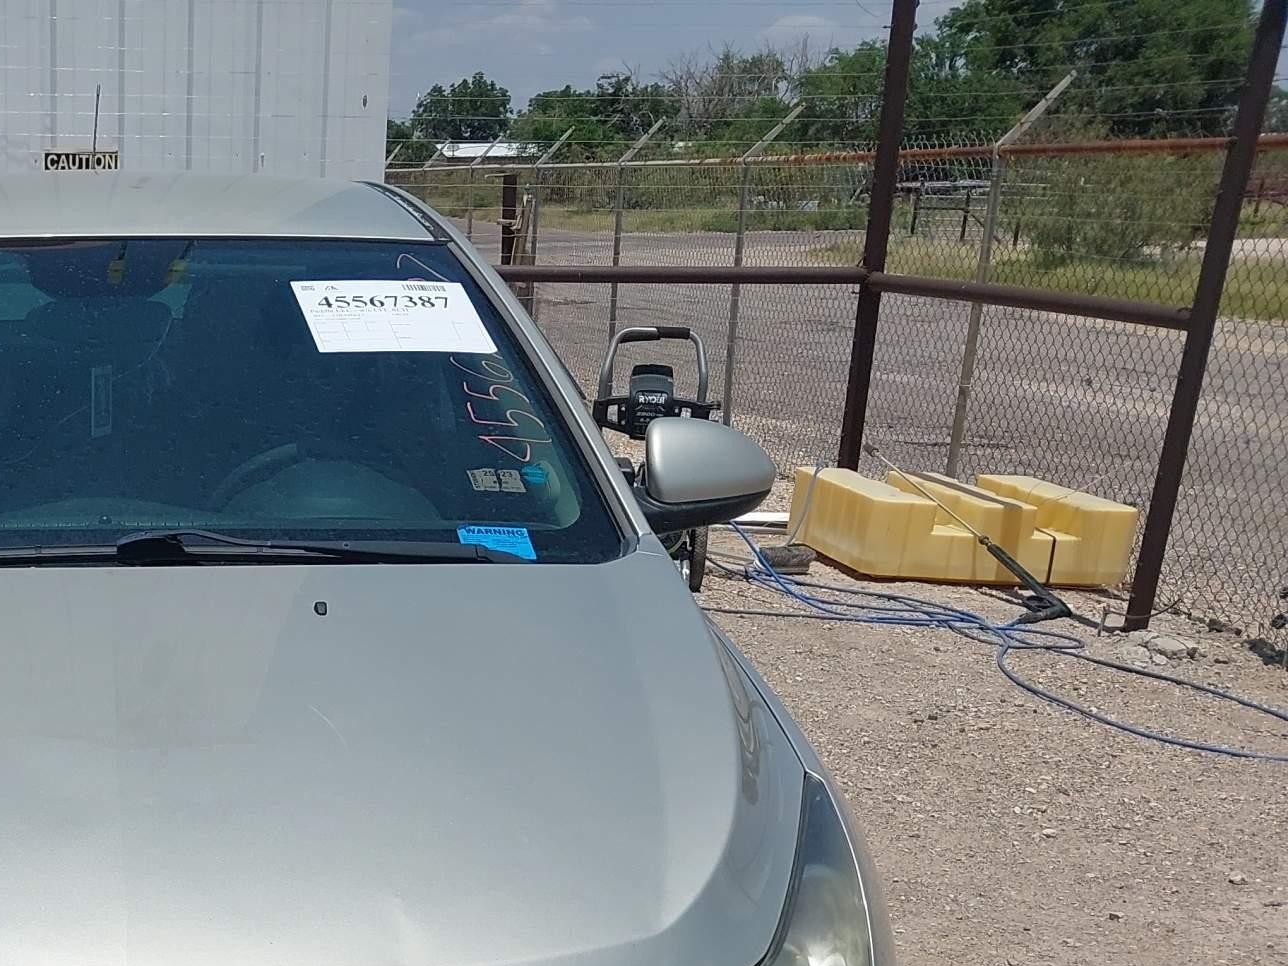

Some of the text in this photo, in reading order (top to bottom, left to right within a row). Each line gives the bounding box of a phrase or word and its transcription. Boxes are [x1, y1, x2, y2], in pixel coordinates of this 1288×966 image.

[46, 154, 116, 170] CAUTION
[317, 295, 449, 309] 45567387
[465, 527, 525, 537] WARNING
